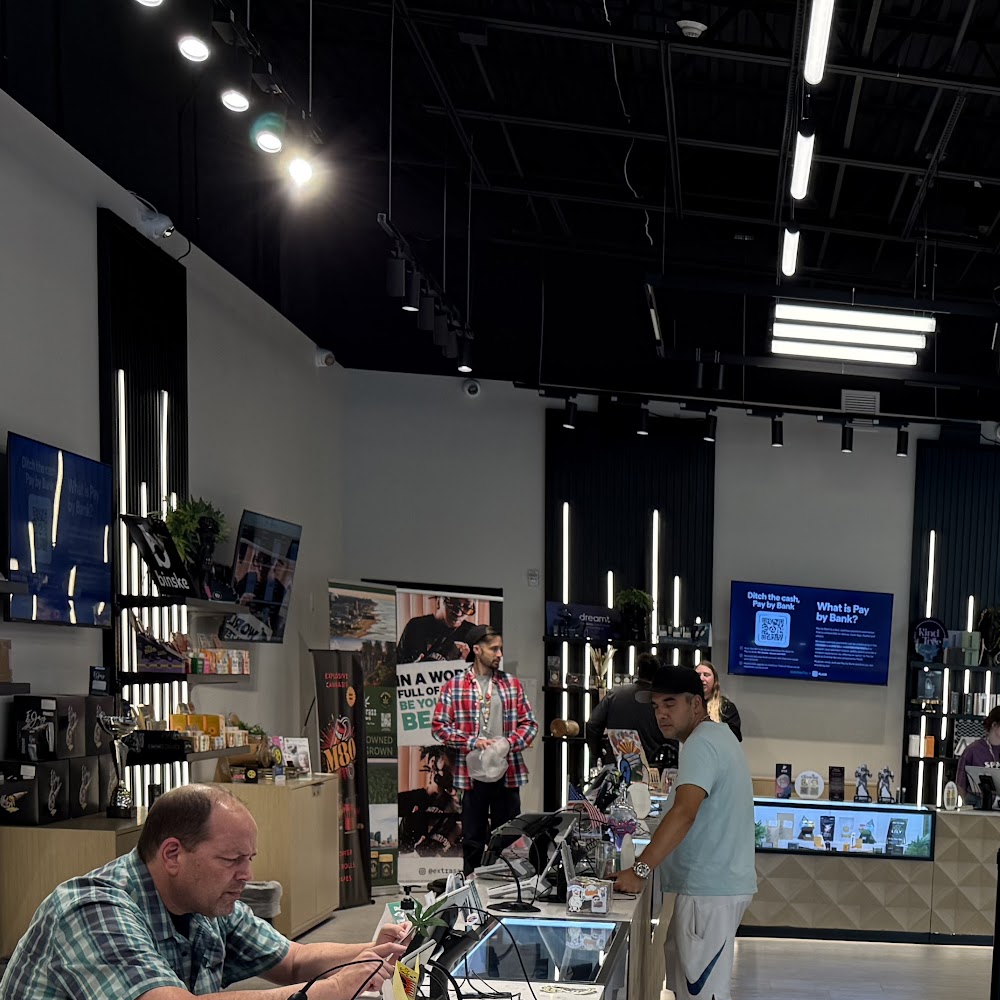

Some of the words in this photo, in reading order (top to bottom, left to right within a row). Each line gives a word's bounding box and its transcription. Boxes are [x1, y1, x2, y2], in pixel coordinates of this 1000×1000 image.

[154, 570, 190, 590] binske
[747, 591, 767, 600] Ditch
[768, 593, 781, 601] the
[781, 595, 800, 604] cash,
[752, 600, 765, 609] Pay
[766, 601, 776, 610] by
[776, 602, 795, 610] Bank
[816, 601, 842, 612] What
[844, 603, 851, 613] is
[853, 605, 870, 616] Pay
[816, 612, 828, 623] by
[829, 613, 858, 624] Bank?
[919, 628, 940, 638] Kind
[397, 674, 411, 686] IN
[416, 672, 426, 685] A
[428, 669, 468, 683] WOR
[398, 688, 425, 699] FULL
[426, 687, 439, 696] OF
[400, 701, 415, 710] BE
[402, 711, 431, 731] BE
[366, 736, 393, 744] OWNED
[324, 738, 356, 773] M80
